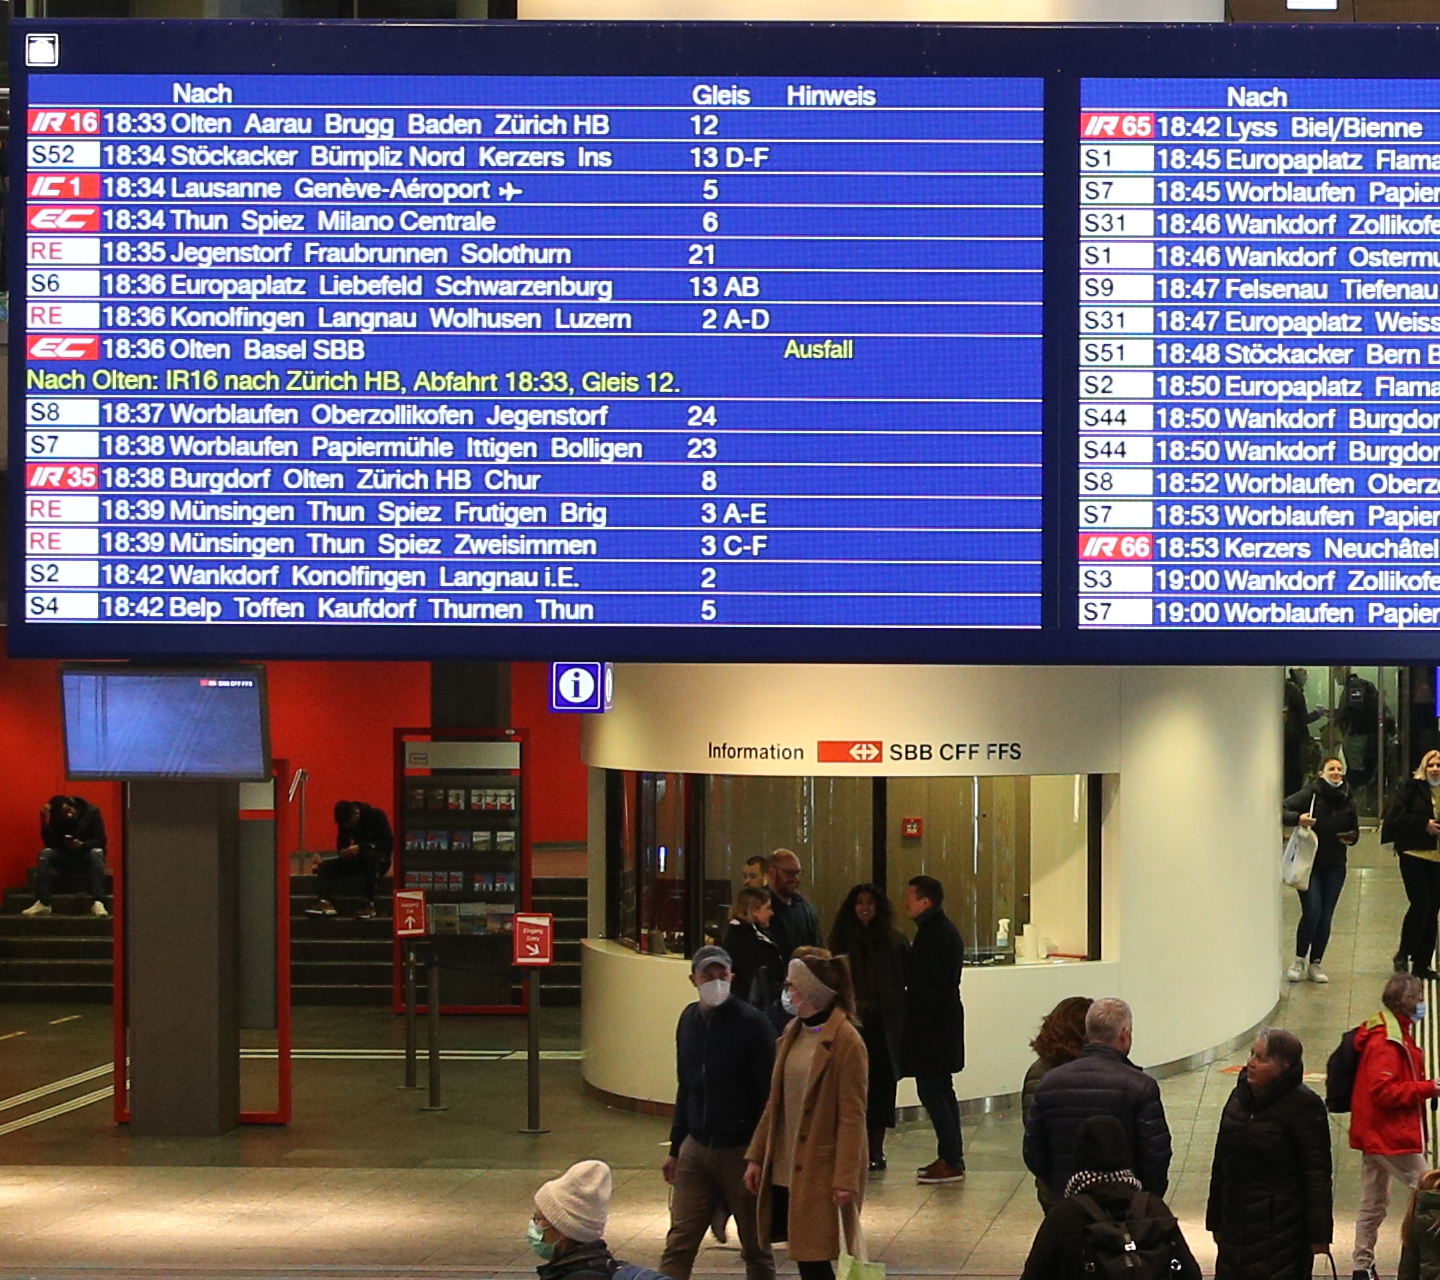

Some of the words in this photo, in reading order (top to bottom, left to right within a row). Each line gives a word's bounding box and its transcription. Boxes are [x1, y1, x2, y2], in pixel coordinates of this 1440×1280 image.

[173, 82, 233, 104] Nach
[692, 84, 751, 106] Gleis
[787, 85, 877, 106] Hinweis
[69, 111, 96, 133] 16
[103, 112, 167, 133] 18:33
[170, 112, 232, 134] Olten
[243, 112, 312, 134] Aarau
[325, 113, 395, 138] Brugg
[408, 113, 482, 135] Baden
[494, 113, 567, 135] Zürich
[573, 114, 610, 135] HB
[690, 114, 718, 135] 12
[1121, 115, 1150, 137] 65
[1157, 116, 1221, 137] 18:42
[1226, 116, 1278, 141] Lyss
[1291, 116, 1423, 141] Biel/Bienne
[69, 176, 80, 197] 1
[102, 178, 166, 200] 18:34
[170, 178, 283, 201] Lausanne
[294, 176, 492, 202] Genève-Aéroport
[703, 179, 719, 200] 5
[1085, 213, 1124, 233] S31
[1156, 213, 1221, 235] 18:46
[1224, 213, 1337, 235] Wankdorf
[102, 338, 166, 359] 18:36
[169, 338, 231, 359] Olten
[244, 338, 307, 360] Basel
[313, 339, 365, 360] SBB
[783, 339, 853, 359] Ausfall
[1085, 343, 1124, 362] S51
[1156, 343, 1222, 364] 18:48
[1224, 344, 1355, 365] Stöckacker
[1366, 344, 1422, 366] Bern
[27, 369, 85, 390] Nach
[92, 369, 158, 390] Olten:
[166, 369, 218, 391] IR16
[224, 370, 280, 391] nach
[285, 370, 358, 391] Zürich
[365, 370, 407, 395] HB,
[413, 371, 498, 392] Abfahrt
[505, 371, 574, 396] 18:33,
[582, 371, 640, 393] Gleis
[646, 372, 680, 393] 12.
[1120, 535, 1150, 557] 66
[1156, 537, 1220, 558] 18:53
[1225, 537, 1312, 559] Kerzers
[1324, 537, 1440, 559] Neuchâtel
[30, 563, 59, 583] S2
[101, 563, 164, 585] 18:42
[168, 564, 280, 586] Wankdorf
[292, 565, 426, 591] Konolfingen
[439, 566, 539, 591] Langnau
[544, 566, 580, 588] i.E.
[701, 567, 716, 588] 2
[708, 741, 805, 761] Information
[889, 744, 933, 761] SBB
[939, 743, 980, 761] CFF
[986, 743, 1022, 761] FFS
